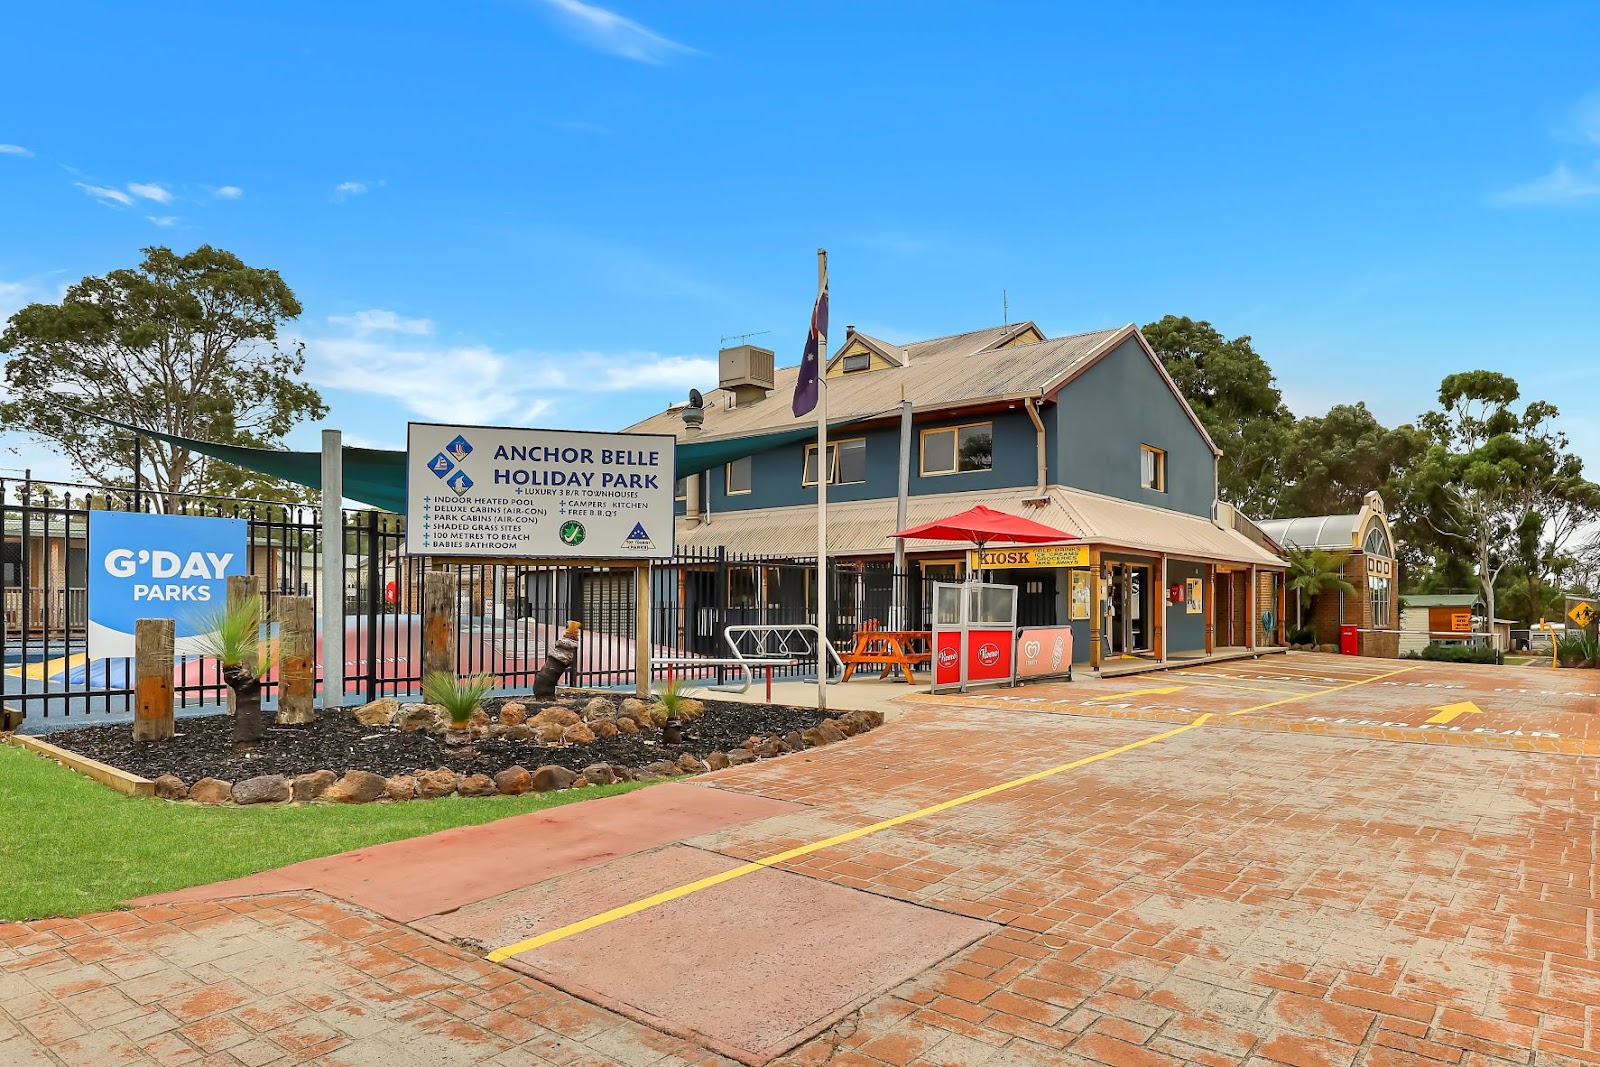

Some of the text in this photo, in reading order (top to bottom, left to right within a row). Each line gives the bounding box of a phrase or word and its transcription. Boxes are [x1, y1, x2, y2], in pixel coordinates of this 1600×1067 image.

[494, 445, 659, 466] ANCHOR BELLE
[494, 469, 658, 490] HOLIDAY PARK
[525, 488, 557, 496] LUXURY
[582, 490, 638, 498] TOWNHOUSES
[434, 496, 472, 504] INDOOR
[568, 500, 607, 508] CAMPERS
[434, 505, 467, 513] DELUXE
[503, 507, 547, 516] (AIR-CON)
[494, 516, 538, 525] (AIR-CON)
[104, 548, 234, 580] G'DAY
[980, 552, 1030, 565] KIOSK
[133, 584, 211, 601] PARKS
